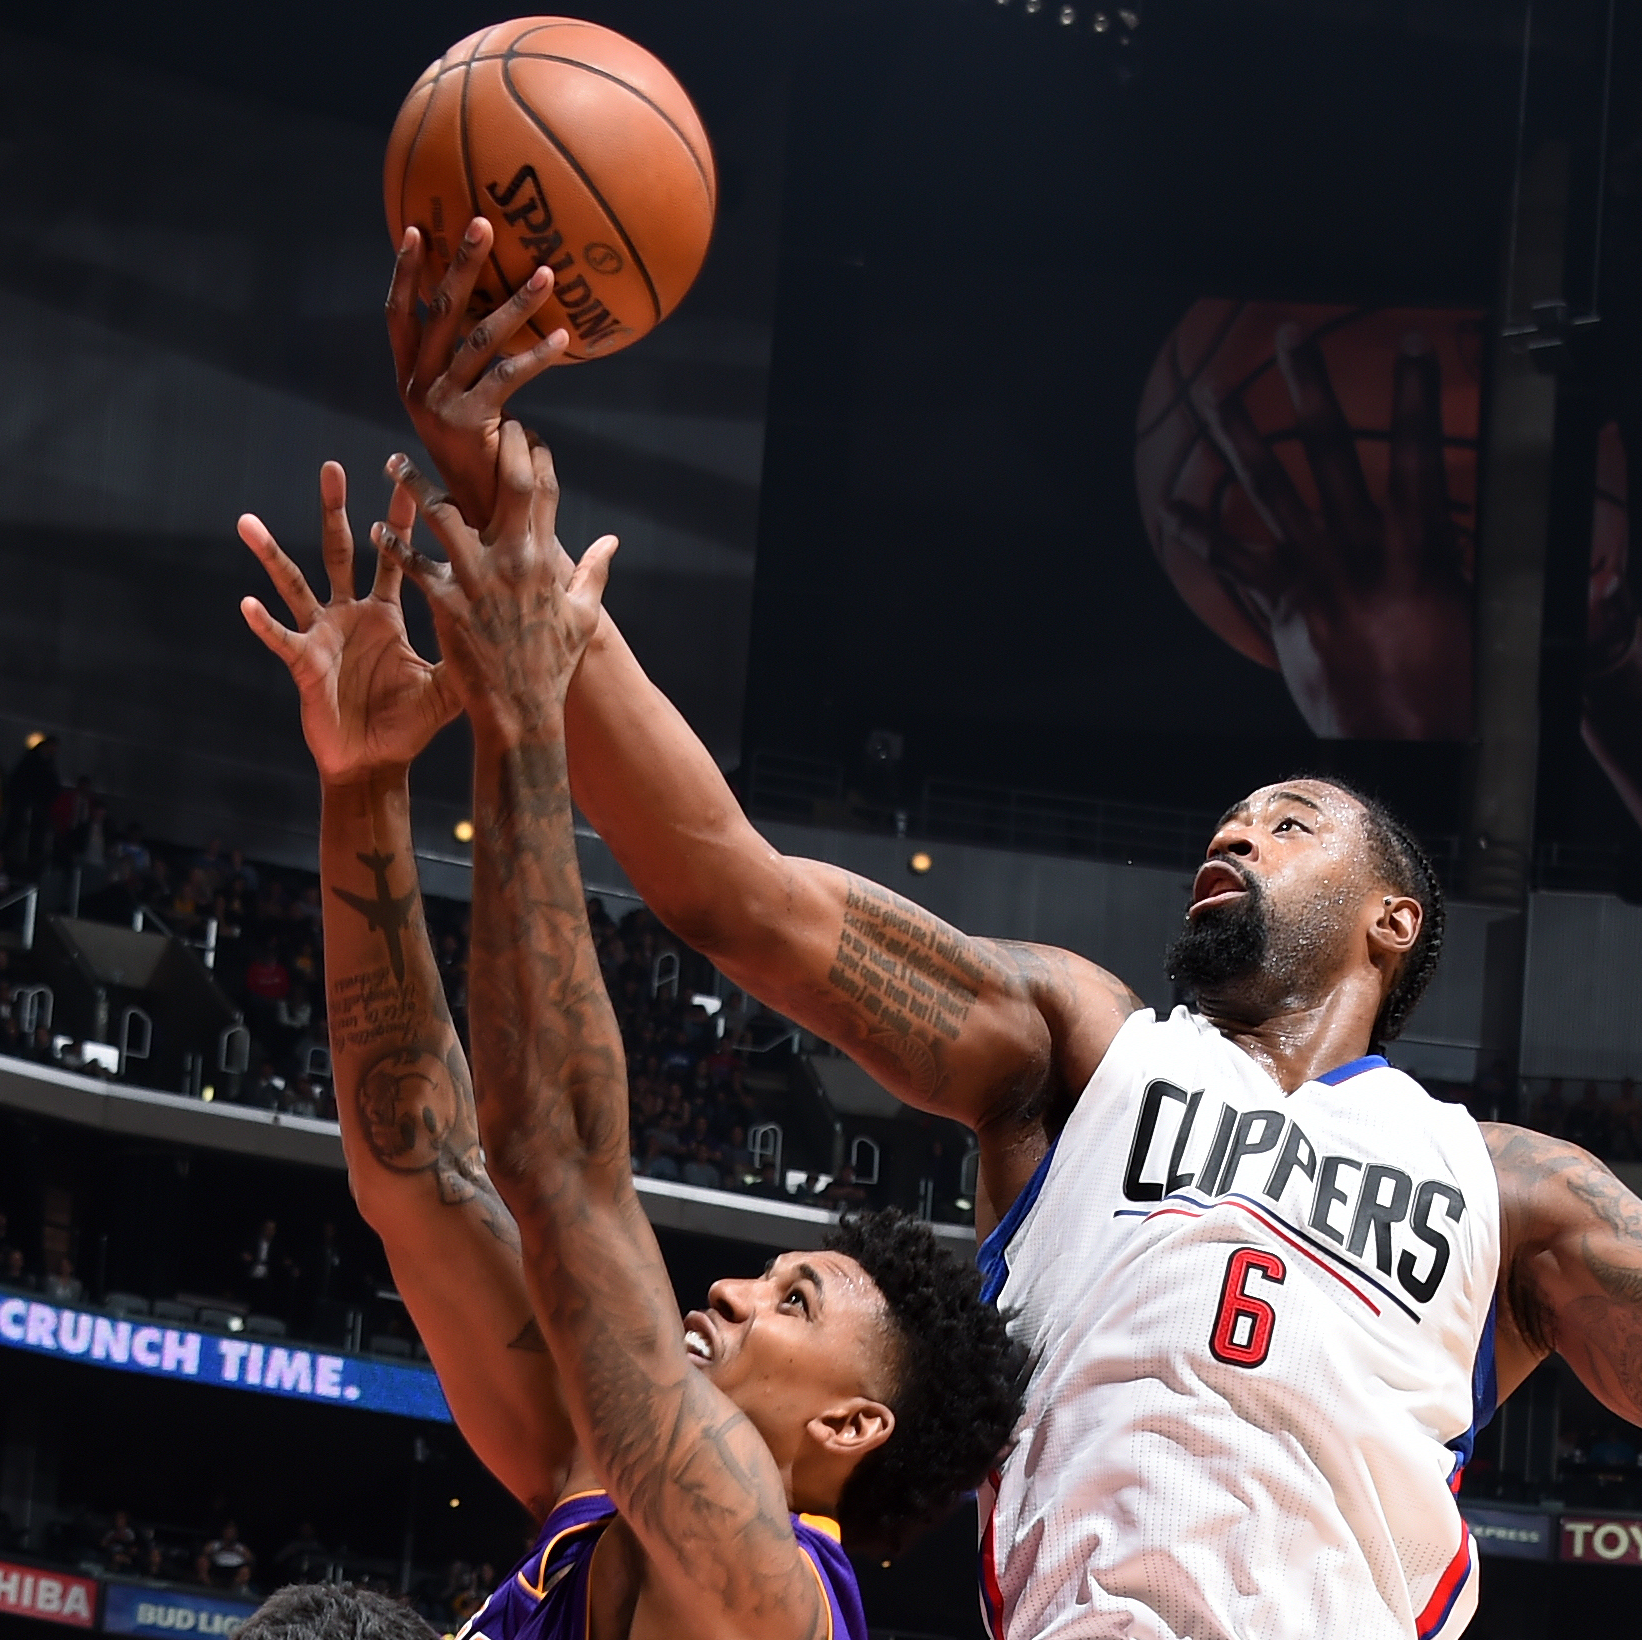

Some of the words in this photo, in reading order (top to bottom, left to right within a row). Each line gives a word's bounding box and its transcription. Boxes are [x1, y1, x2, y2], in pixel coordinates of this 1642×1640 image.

[1123, 1078, 1466, 1303] CLIPPERS
[1209, 1247, 1287, 1369] 6
[219, 1339, 361, 1400] TIME.
[1470, 1525, 1540, 1544] XPRESS
[136, 1602, 195, 1630] BUD
[198, 1611, 246, 1636] LIG
